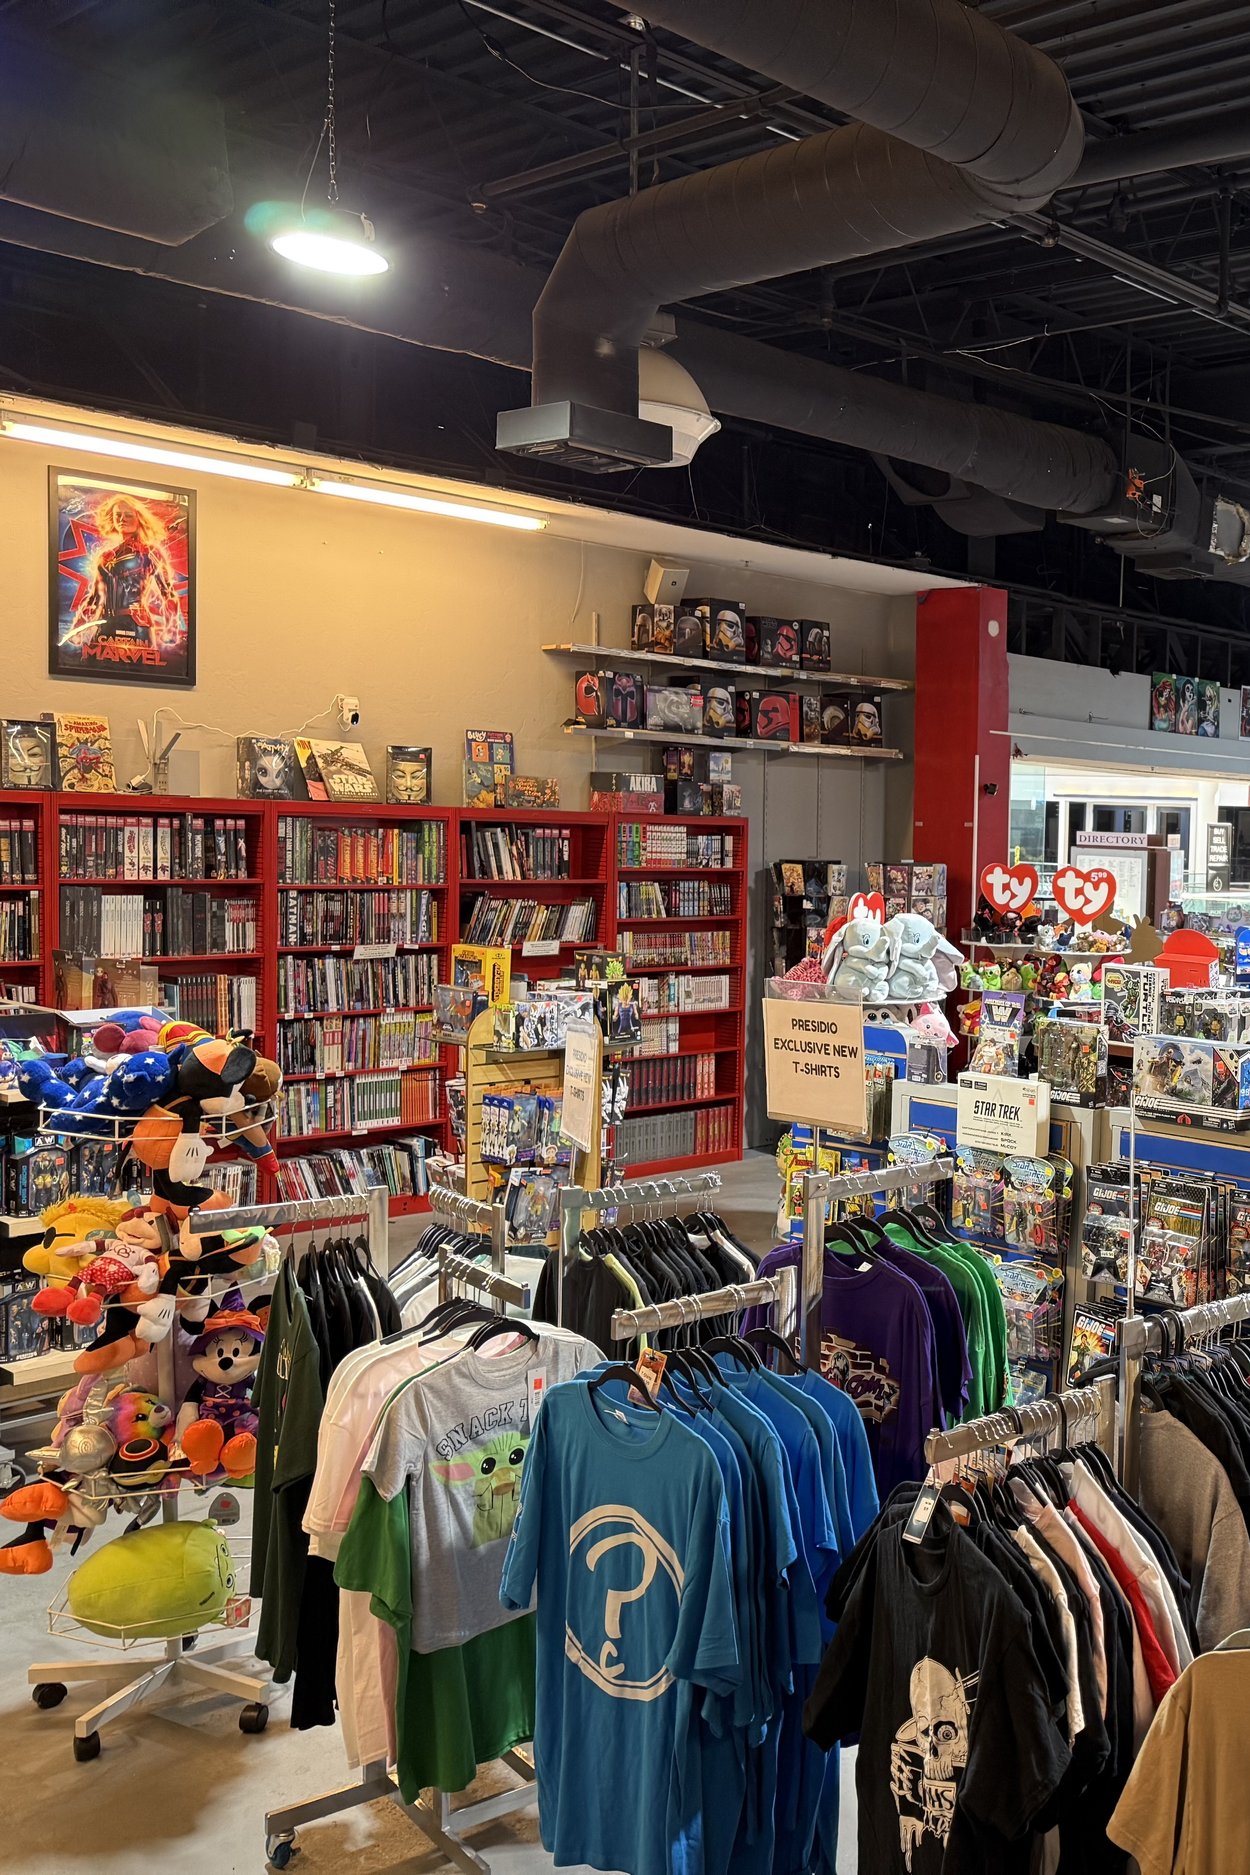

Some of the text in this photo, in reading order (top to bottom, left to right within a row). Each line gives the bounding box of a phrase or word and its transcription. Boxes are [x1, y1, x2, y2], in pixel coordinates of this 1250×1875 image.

[82, 645, 168, 667] MARVEL
[329, 779, 374, 794] WARS
[331, 774, 369, 785] STAR
[629, 776, 657, 792] AKIRA
[1078, 834, 1147, 846] DIRECTORY
[1212, 836, 1226, 844] SELL
[1210, 845, 1228, 853] TRADE
[1209, 854, 1229, 863] REPAIR
[985, 866, 1032, 910] ty
[1056, 870, 1109, 915] ty
[288, 890, 299, 942] BATMAN
[1142, 972, 1150, 1033] TURTLE
[791, 1018, 838, 1035] PRESIDIO
[773, 1038, 859, 1059] EXCLUSIVE NEW
[792, 1061, 840, 1079] T-SHIRTS
[973, 1099, 1021, 1122] STAR TREK
[1012, 1160, 1030, 1171] STAR
[1004, 1270, 1019, 1281] STAR
[436, 1401, 516, 1462] SNACK
